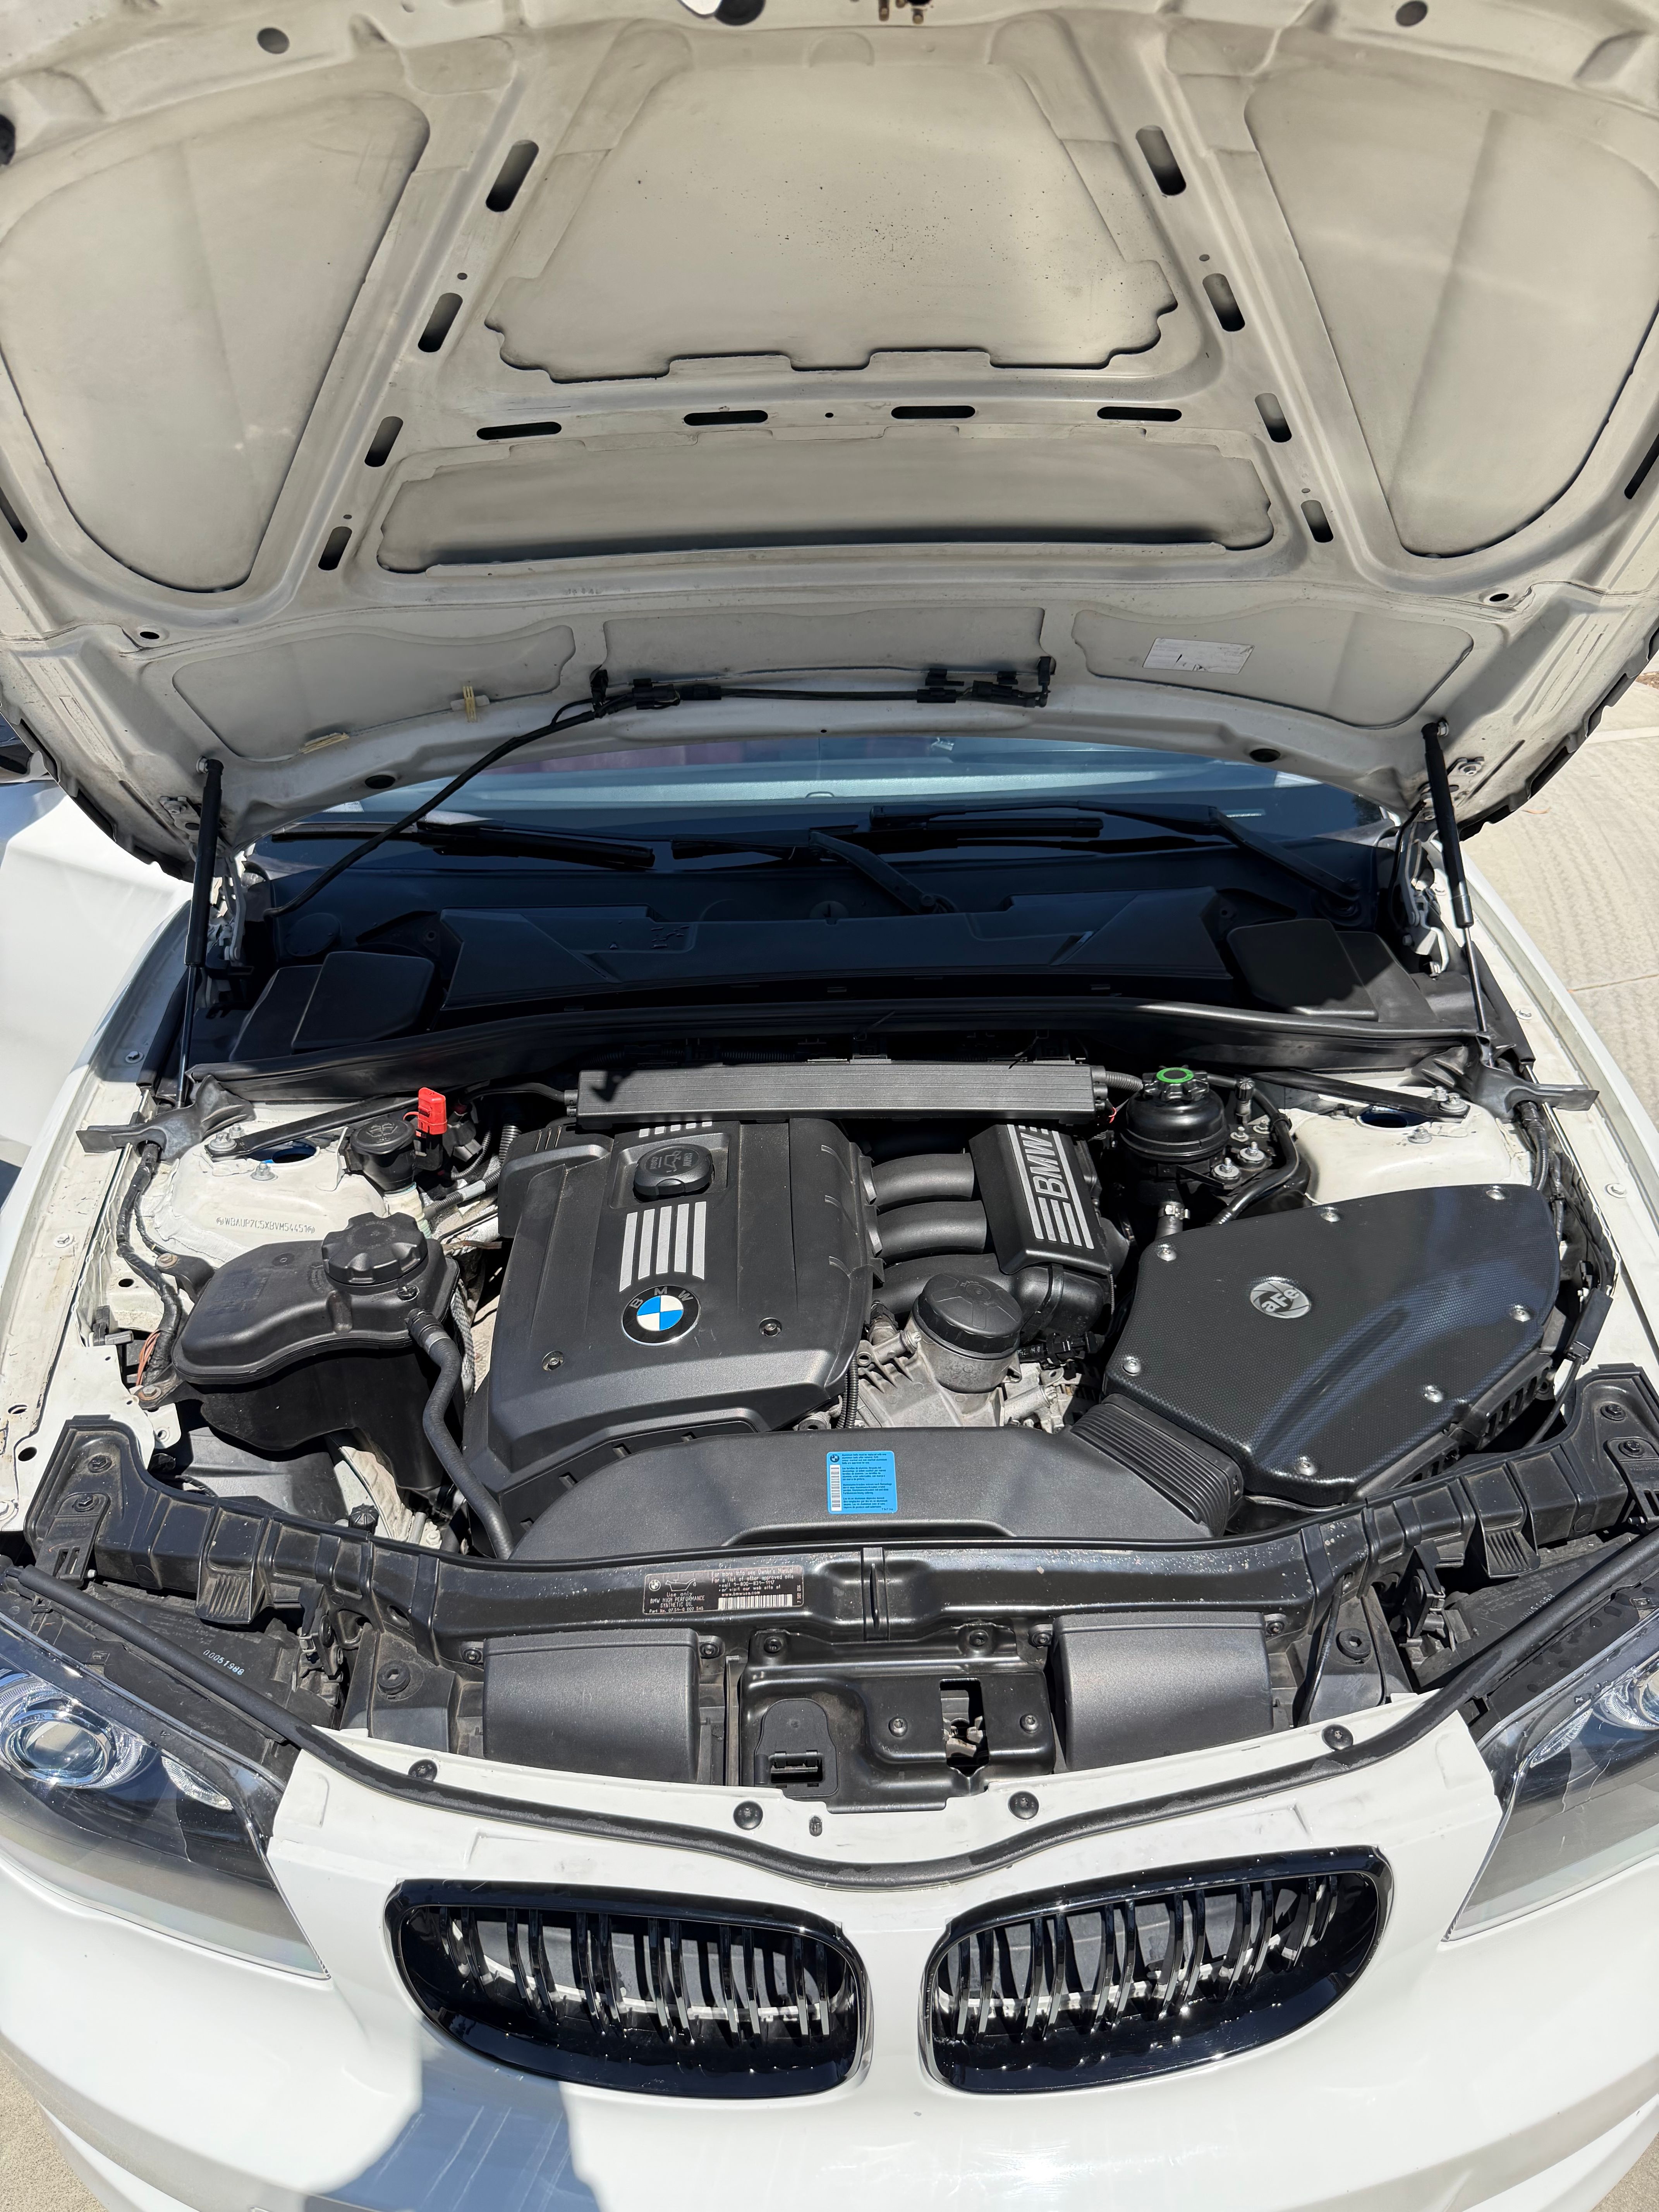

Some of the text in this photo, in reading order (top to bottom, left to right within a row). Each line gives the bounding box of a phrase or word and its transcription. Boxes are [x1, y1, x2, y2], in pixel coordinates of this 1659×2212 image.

[1020, 1133, 1069, 1199] BMW
[629, 1286, 694, 1309] BMW
[1261, 1289, 1299, 1312] aFe
